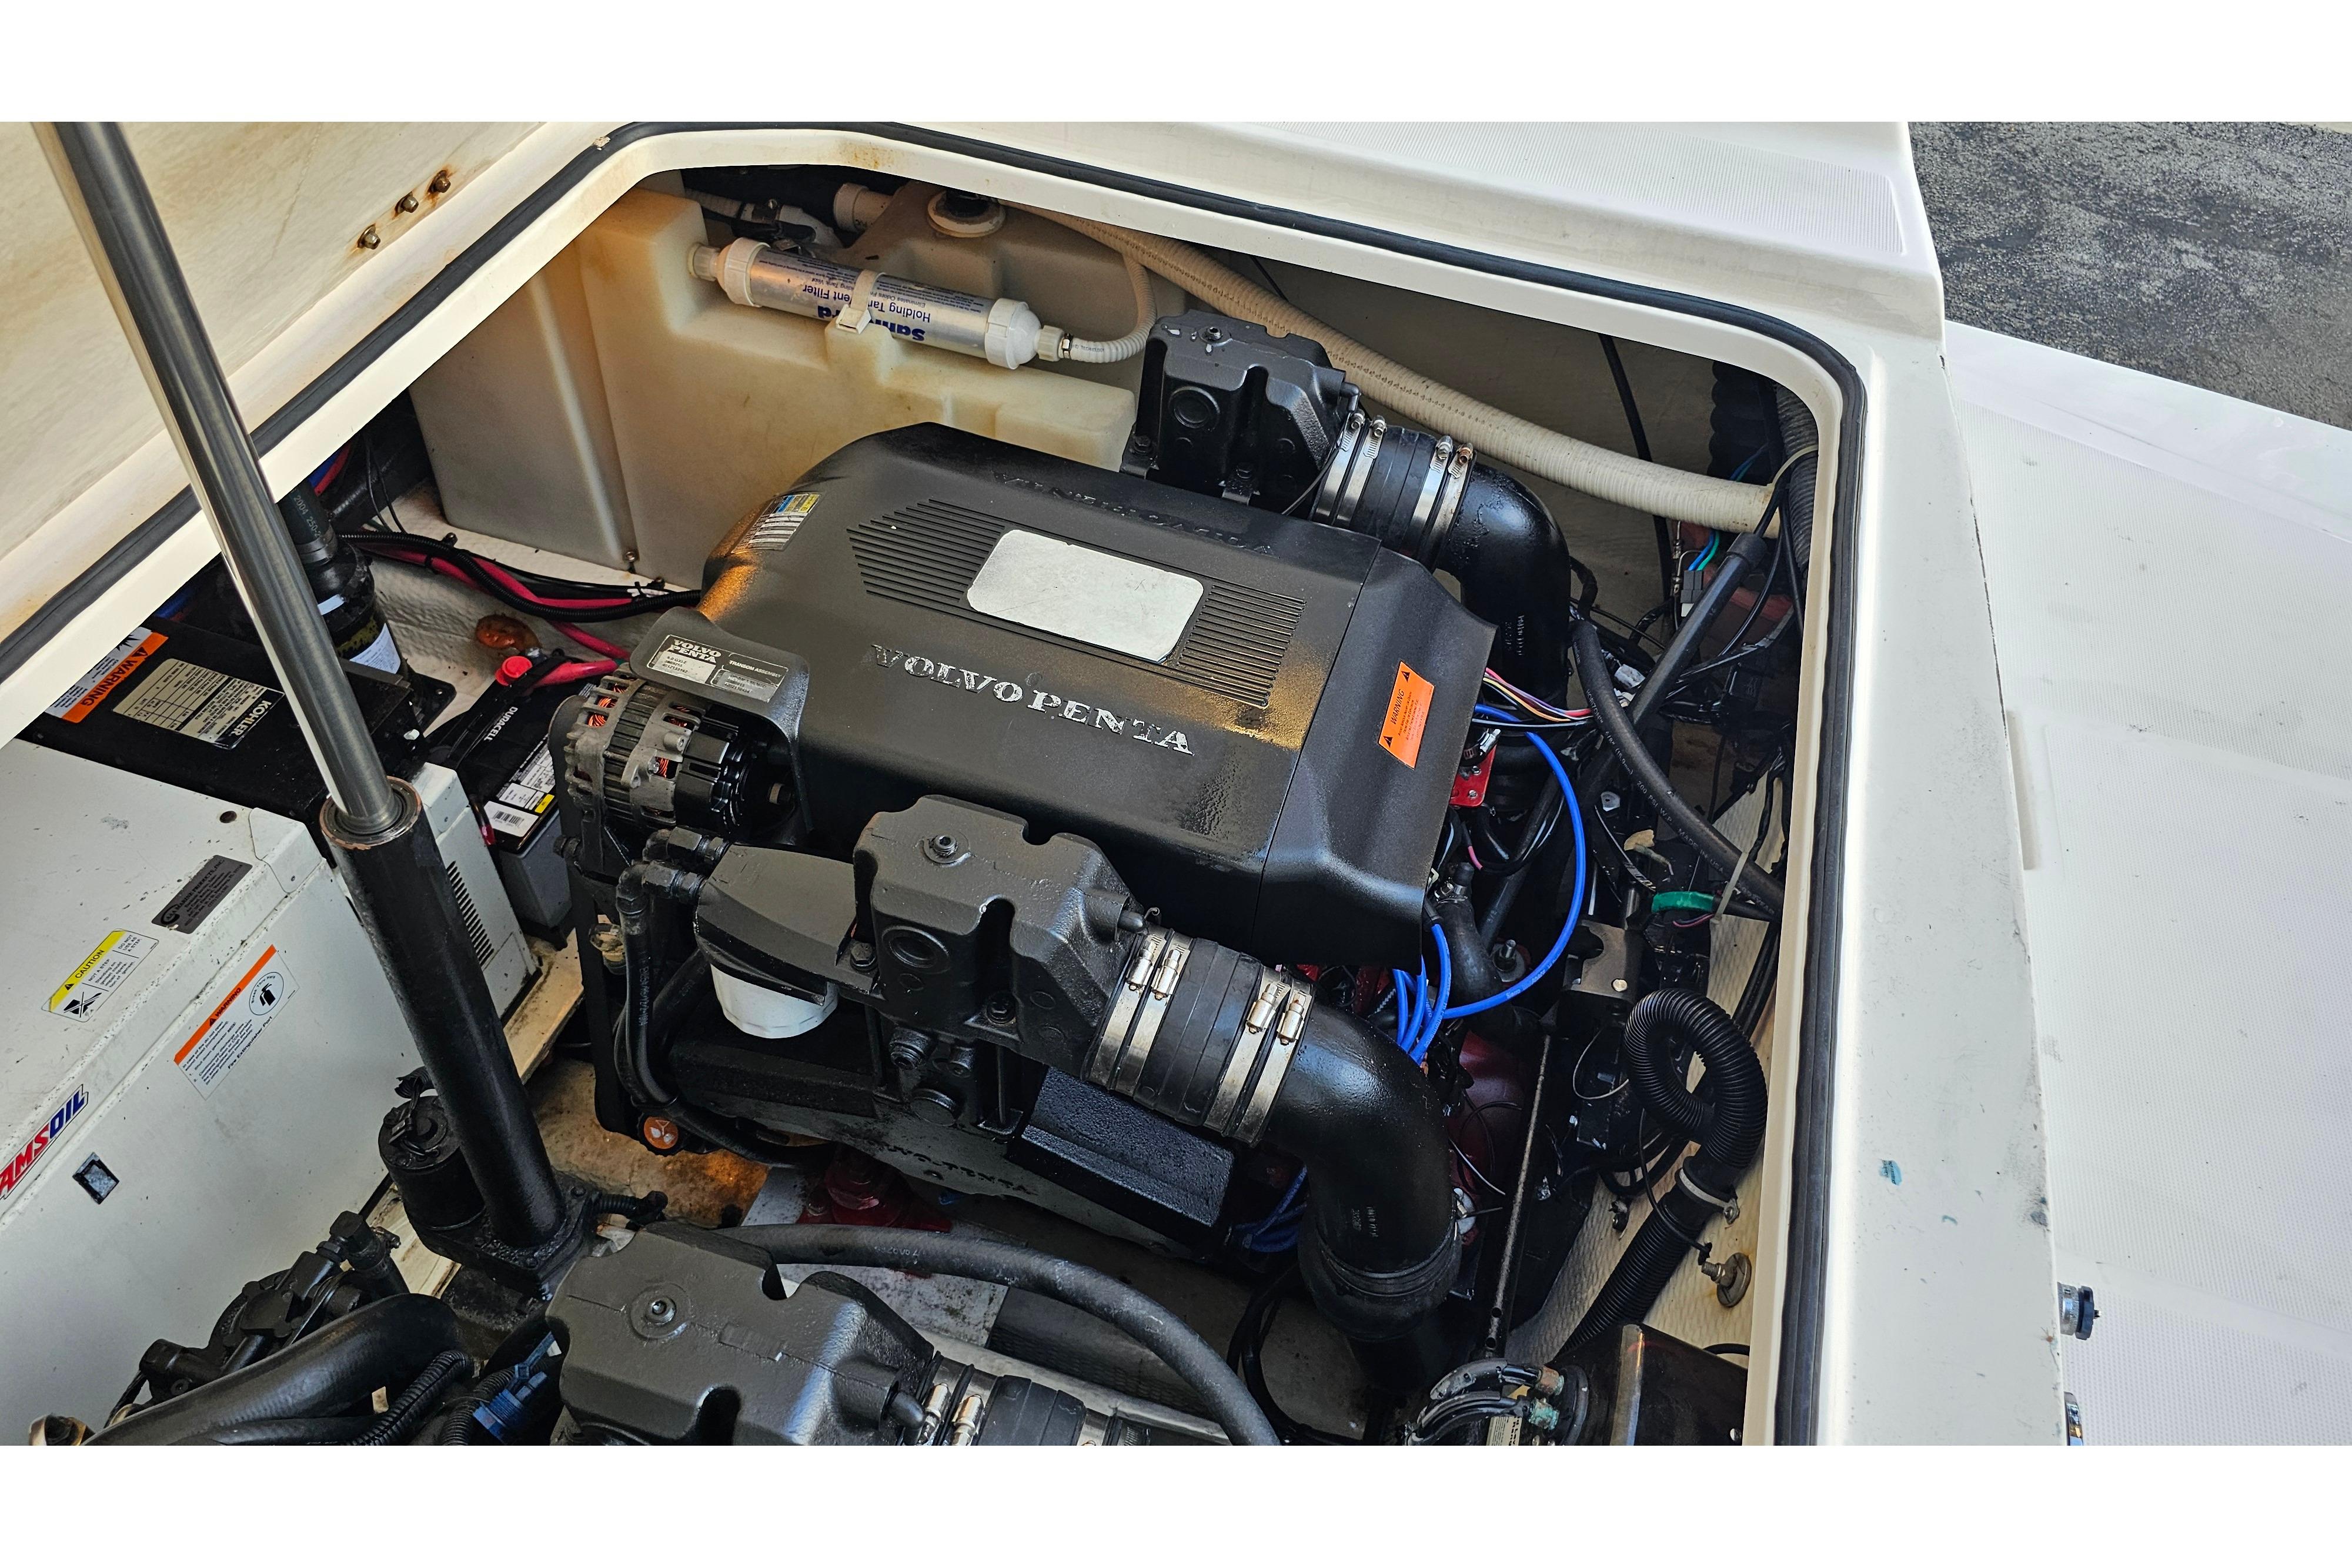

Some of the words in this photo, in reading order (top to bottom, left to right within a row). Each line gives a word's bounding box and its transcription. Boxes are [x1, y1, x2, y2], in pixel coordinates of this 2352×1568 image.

[801, 284, 830, 299] Filter
[831, 291, 853, 304] ent
[878, 292, 895, 300] Odors
[896, 296, 926, 307] Eliminates
[888, 302, 931, 322] Holding
[292, 494, 310, 515] 2004
[667, 644, 719, 663] PENTA
[671, 638, 722, 658] VOLVO
[728, 660, 756, 671] TRANSOM
[754, 667, 781, 678] ASSEMBLY
[80, 658, 138, 707] WARNING
[871, 644, 1024, 703] VOLVO
[1028, 689, 1194, 756] PENTA
[1389, 687, 1404, 726] WARNING
[229, 700, 273, 736] KOHLER
[485, 706, 518, 741] DURACELL
[1611, 747, 1636, 775] (15.9mm)
[1635, 780, 1648, 794] 200
[1647, 794, 1659, 808] PSI
[1676, 827, 1699, 850] MADE
[1699, 849, 1708, 858] IN
[1708, 858, 1725, 874] USA
[174, 892, 193, 910] MARINE
[122, 942, 132, 950] USE
[123, 934, 133, 942] NOT
[74, 949, 105, 979] CAUTION
[88, 972, 98, 981] NOT
[99, 958, 110, 969] STEP
[95, 967, 112, 983] Standing
[99, 972, 113, 985] genset
[111, 961, 122, 971] could
[103, 974, 116, 986] impair
[108, 979, 117, 988] tion
[215, 987, 242, 1018] WARNING
[1505, 987, 1521, 999] Sierra
[214, 1021, 223, 1032] open
[193, 1060, 203, 1071] Shut
[202, 1049, 212, 1061] down
[211, 1032, 228, 1051] generator
[198, 1051, 220, 1076] Continuously
[219, 1033, 236, 1052] discharge
[234, 1022, 244, 1034] entire
[200, 1064, 213, 1079] contents
[218, 1046, 228, 1059] halon
[231, 1034, 239, 1043] CO2
[239, 1018, 253, 1035] portable
[208, 1054, 227, 1076] extinguisher
[226, 1038, 240, 1055] through
[244, 1024, 253, 1034] port
[226, 1057, 237, 1069] Fire
[236, 1027, 263, 1059] Extinguisher
[262, 1015, 273, 1028] Port
[185, 1058, 196, 1071] sound
[195, 1047, 206, 1059] shield
[210, 1068, 219, 1079] other
[218, 1049, 235, 1069] provision)
[0, 1088, 87, 1197] AMSOIL
